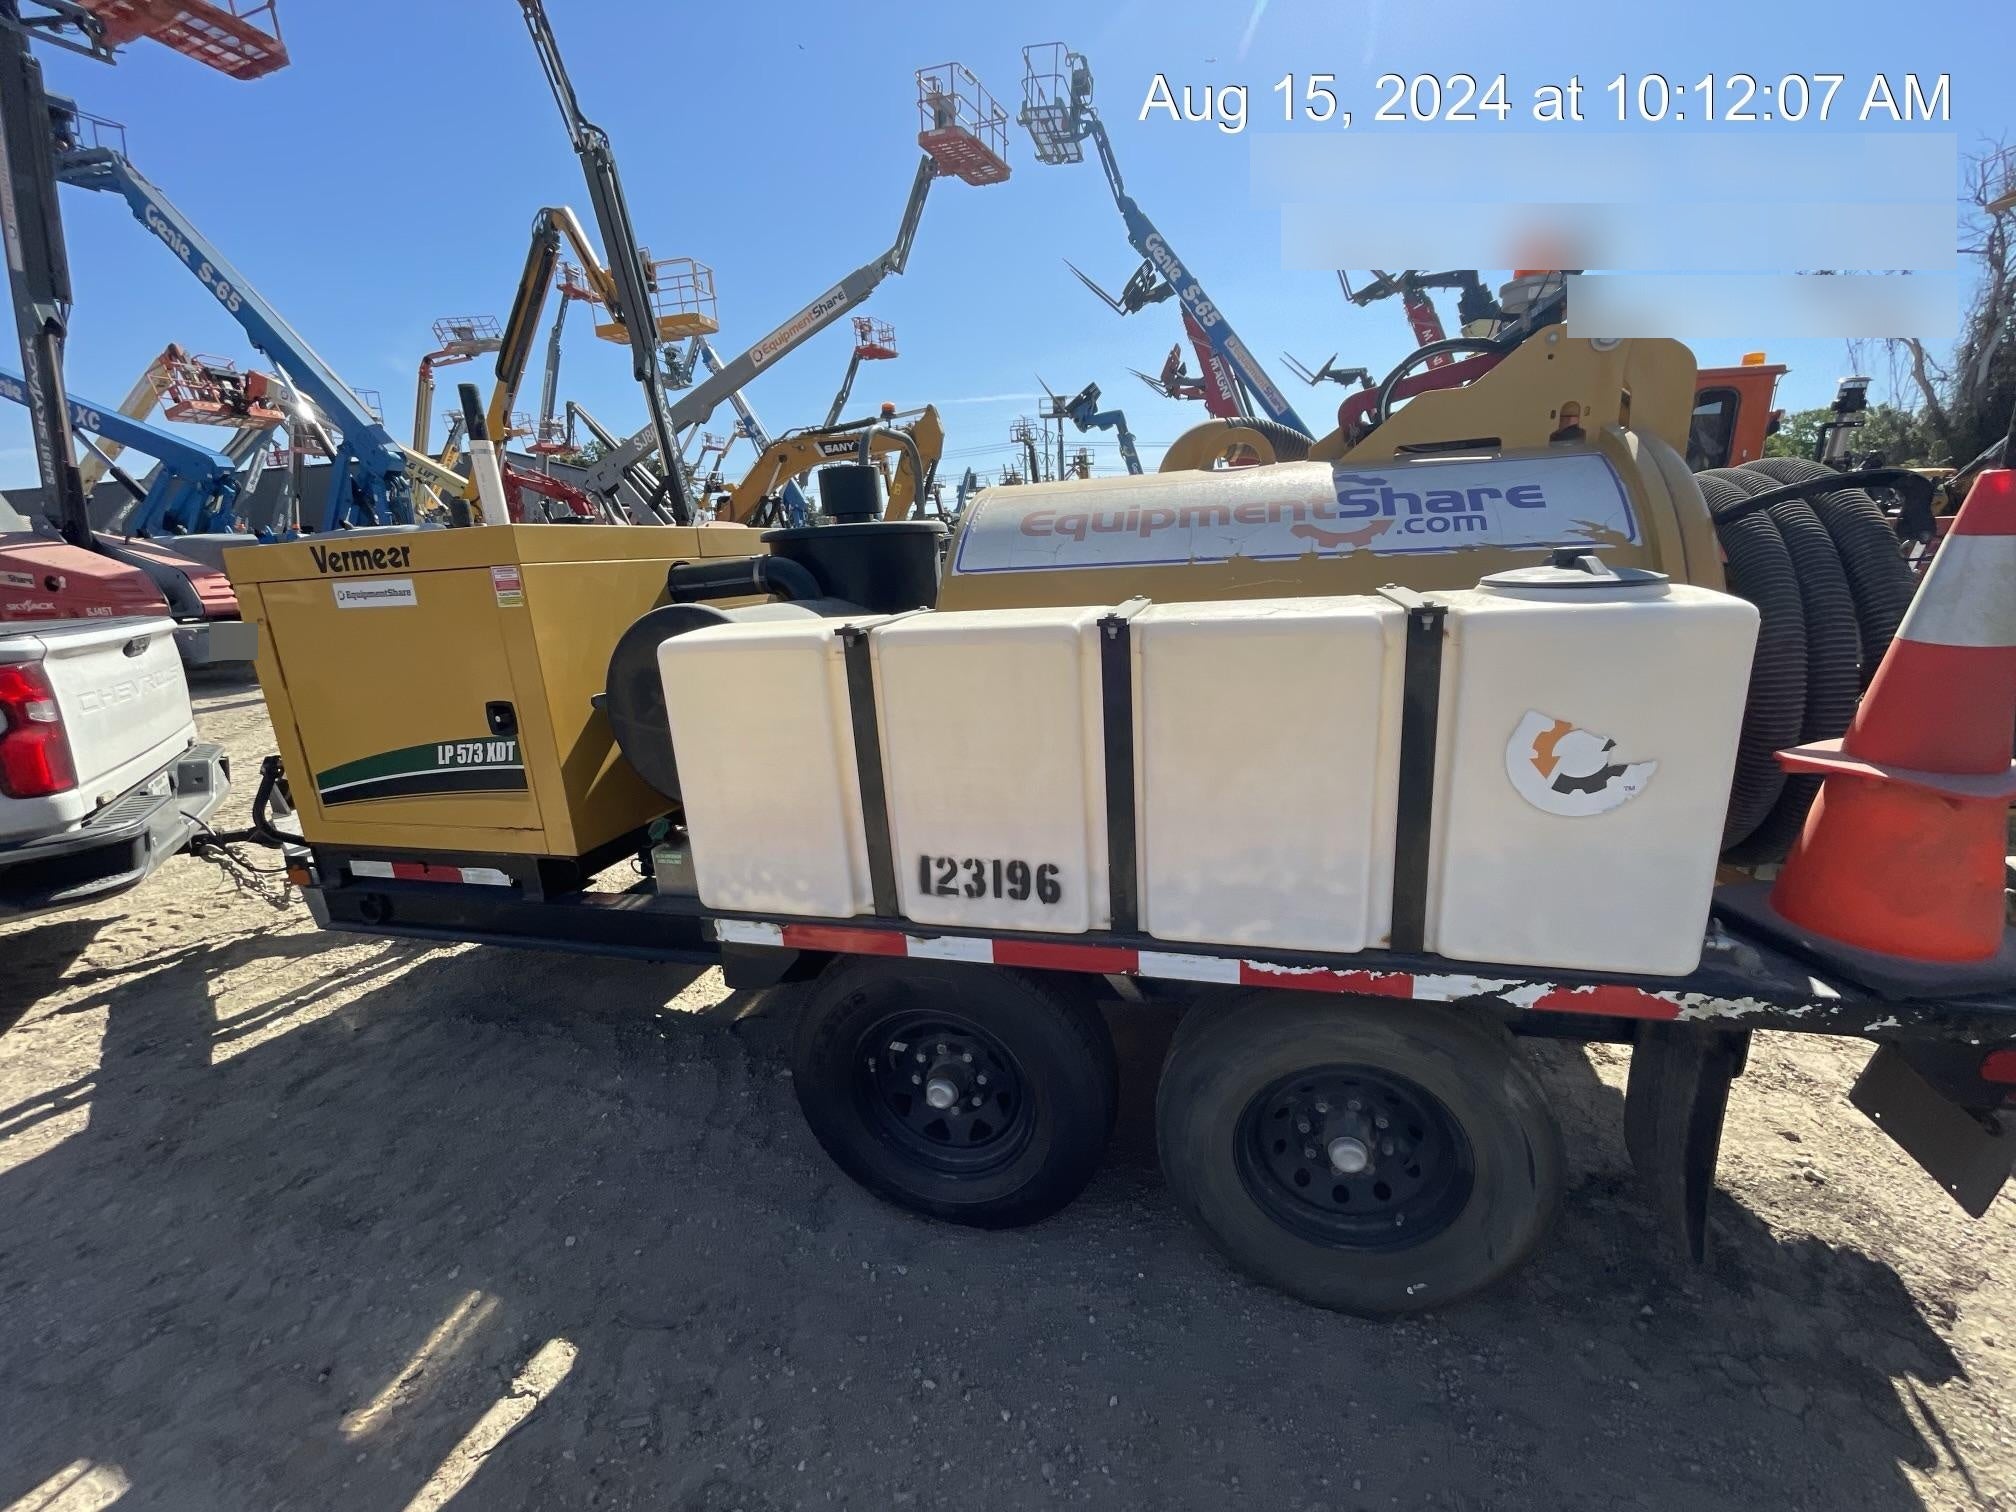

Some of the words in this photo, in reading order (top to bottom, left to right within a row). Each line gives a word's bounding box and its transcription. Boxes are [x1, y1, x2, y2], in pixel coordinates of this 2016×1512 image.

[145, 203, 191, 264] Genie
[197, 261, 242, 312] S-65
[1145, 232, 1182, 283] Genie
[1182, 284, 1221, 327] S-65
[762, 291, 846, 355] EquipmentShare
[1208, 356, 1232, 401] MAGNI
[76, 405, 100, 431] XC
[824, 442, 855, 454] SANY
[1019, 483, 1548, 542] EquipmentShare
[1397, 514, 1488, 535] .com
[309, 545, 411, 574] Vermeer
[6, 600, 56, 612] SKYJACK
[345, 588, 412, 601] EquipmentShare
[437, 745, 454, 765] LP
[456, 743, 484, 764] 573
[486, 741, 516, 763] XDT
[919, 855, 1062, 904] 123196
